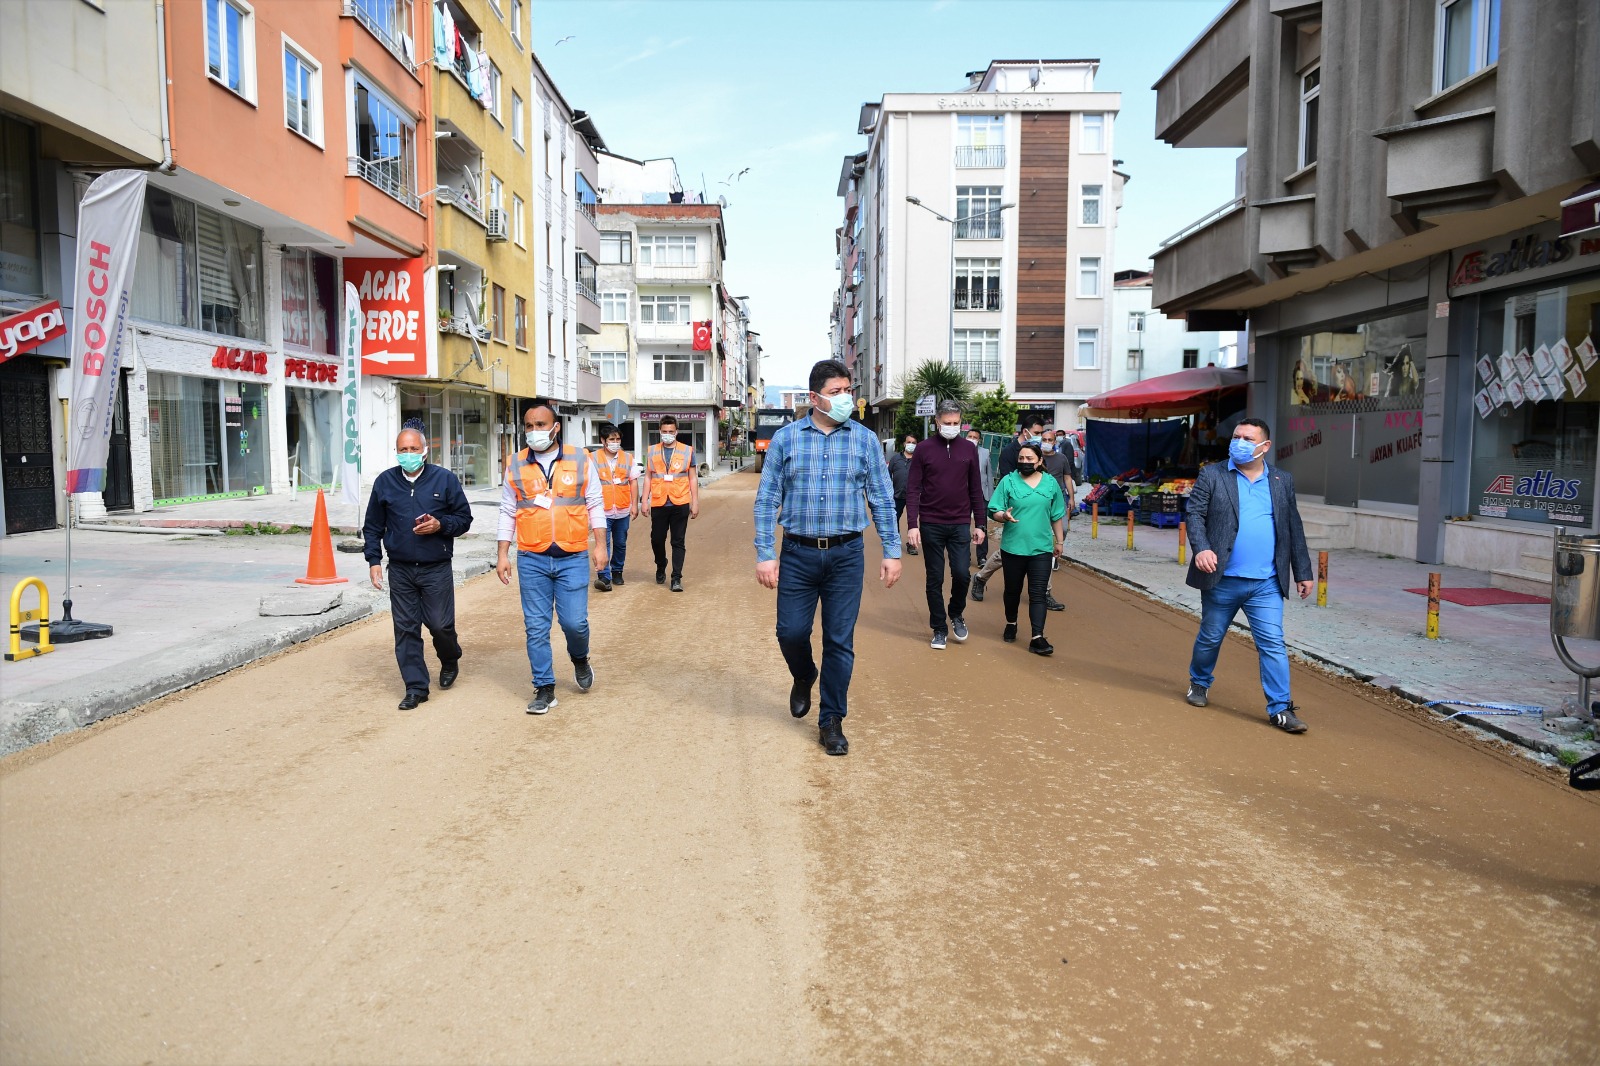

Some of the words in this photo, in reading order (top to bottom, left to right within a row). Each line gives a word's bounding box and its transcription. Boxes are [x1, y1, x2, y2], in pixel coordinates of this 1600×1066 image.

[937, 93, 986, 109] ŞAHİN
[994, 93, 1055, 109] İNŞAAT
[359, 270, 411, 303] ACAR
[82, 240, 111, 377] BOSCH
[102, 290, 129, 439] Termoteknoloji
[212, 345, 268, 375] ACAR
[284, 358, 339, 383] PERDE
[1384, 411, 1423, 432] AYÇA
[1516, 470, 1582, 501] atlas
[1483, 497, 1520, 508] EMLAK
[1534, 499, 1582, 514] İNŞAAT
